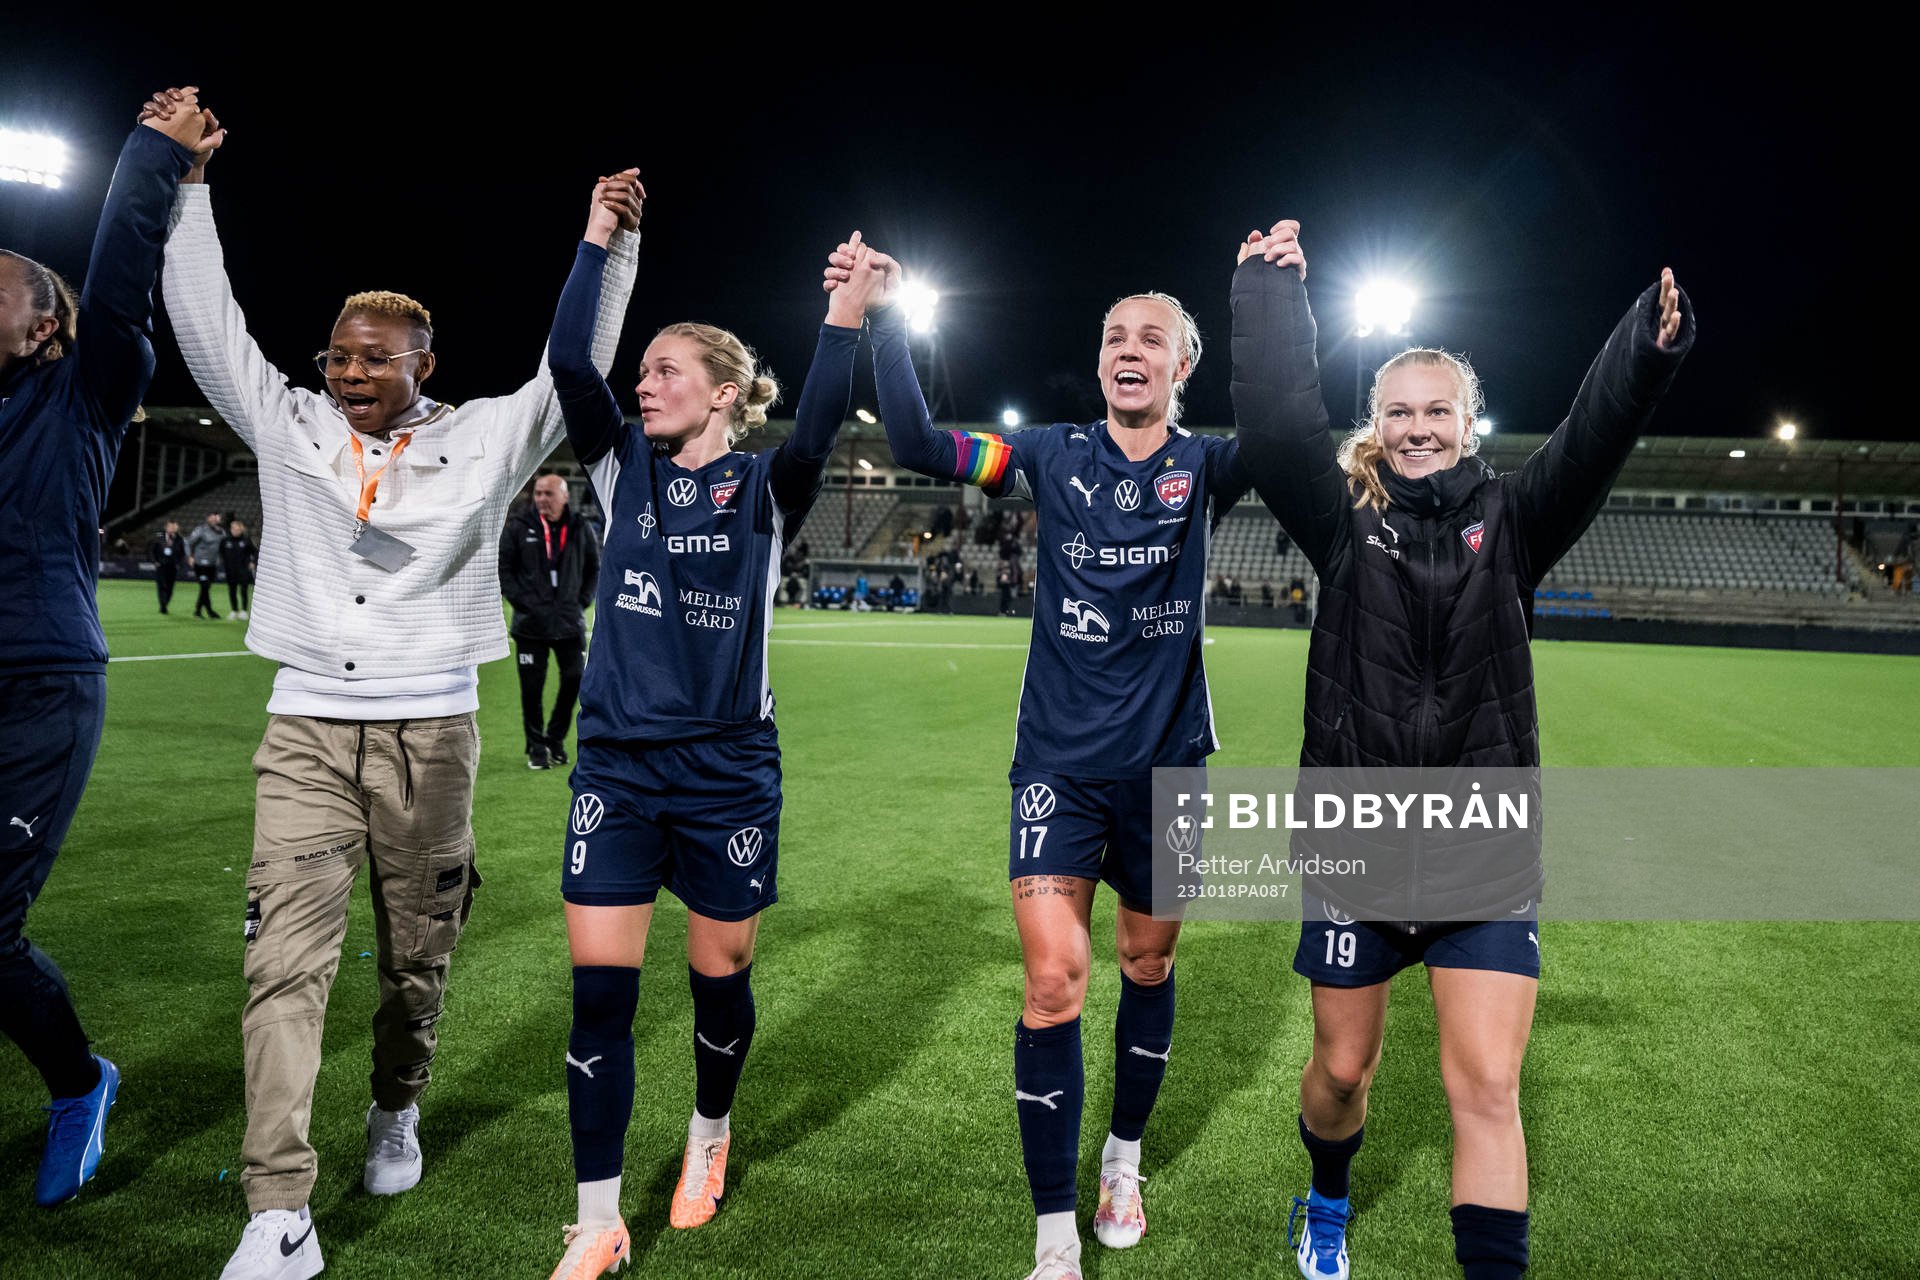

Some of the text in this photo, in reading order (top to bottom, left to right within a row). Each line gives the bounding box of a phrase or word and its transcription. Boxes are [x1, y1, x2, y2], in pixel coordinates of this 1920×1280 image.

[715, 487, 737, 498] FC
[1161, 480, 1187, 495] FCR
[618, 593, 639, 604] OTTO
[679, 588, 742, 611] MELLBY
[615, 599, 661, 618] MAGNUSSON
[1131, 600, 1191, 621] MELLBY
[685, 609, 735, 630] GÅRD
[1060, 622, 1078, 632] OTTO
[1060, 629, 1108, 643] MAGNUSSON
[1142, 620, 1184, 639] GÅRD
[1019, 826, 1048, 860] 17
[294, 850, 329, 862] BLACK
[571, 840, 587, 875] 9
[1325, 929, 1357, 967] 19
